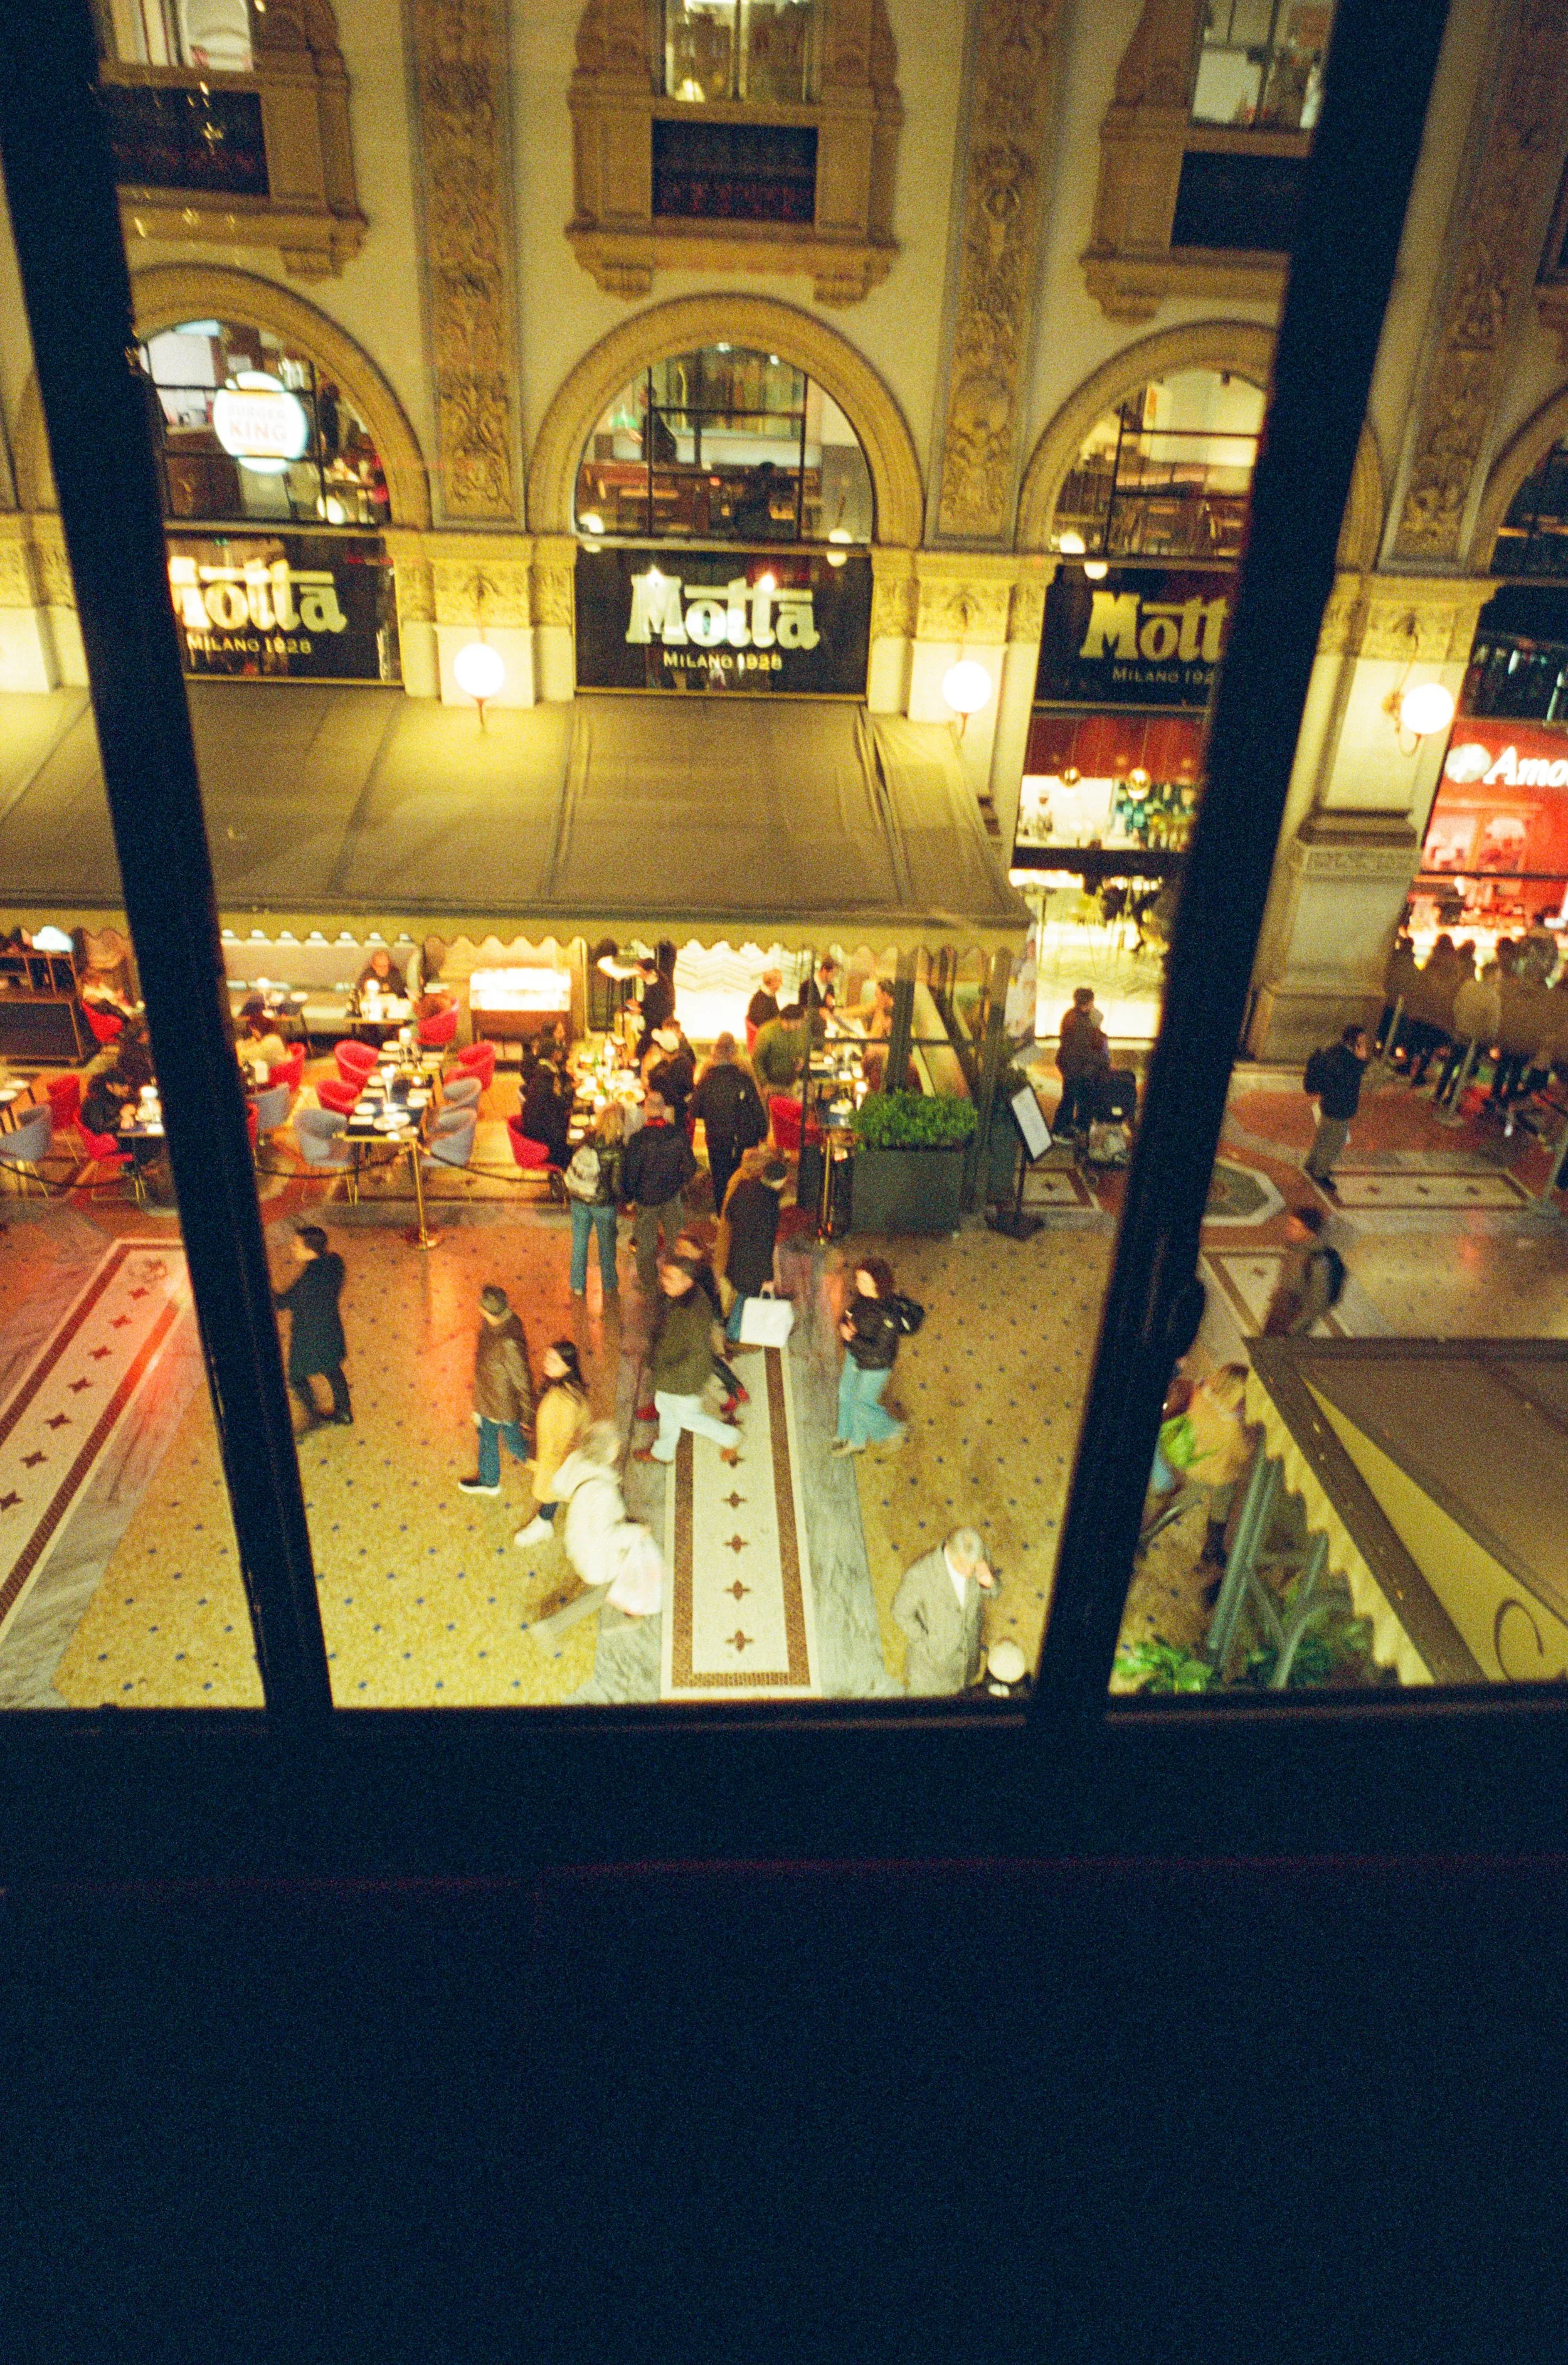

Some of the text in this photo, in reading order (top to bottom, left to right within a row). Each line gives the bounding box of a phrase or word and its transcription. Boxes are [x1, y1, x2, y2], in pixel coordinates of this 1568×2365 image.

[228, 405, 287, 420] BURGER
[230, 421, 287, 443] KING
[625, 574, 820, 649] Motta
[1079, 590, 1229, 663] Mott
[187, 632, 311, 654] MILANO 1928
[663, 651, 783, 671] MILANO 1928
[1112, 666, 1179, 684] MILANO
[1482, 745, 1568, 787] Amo
